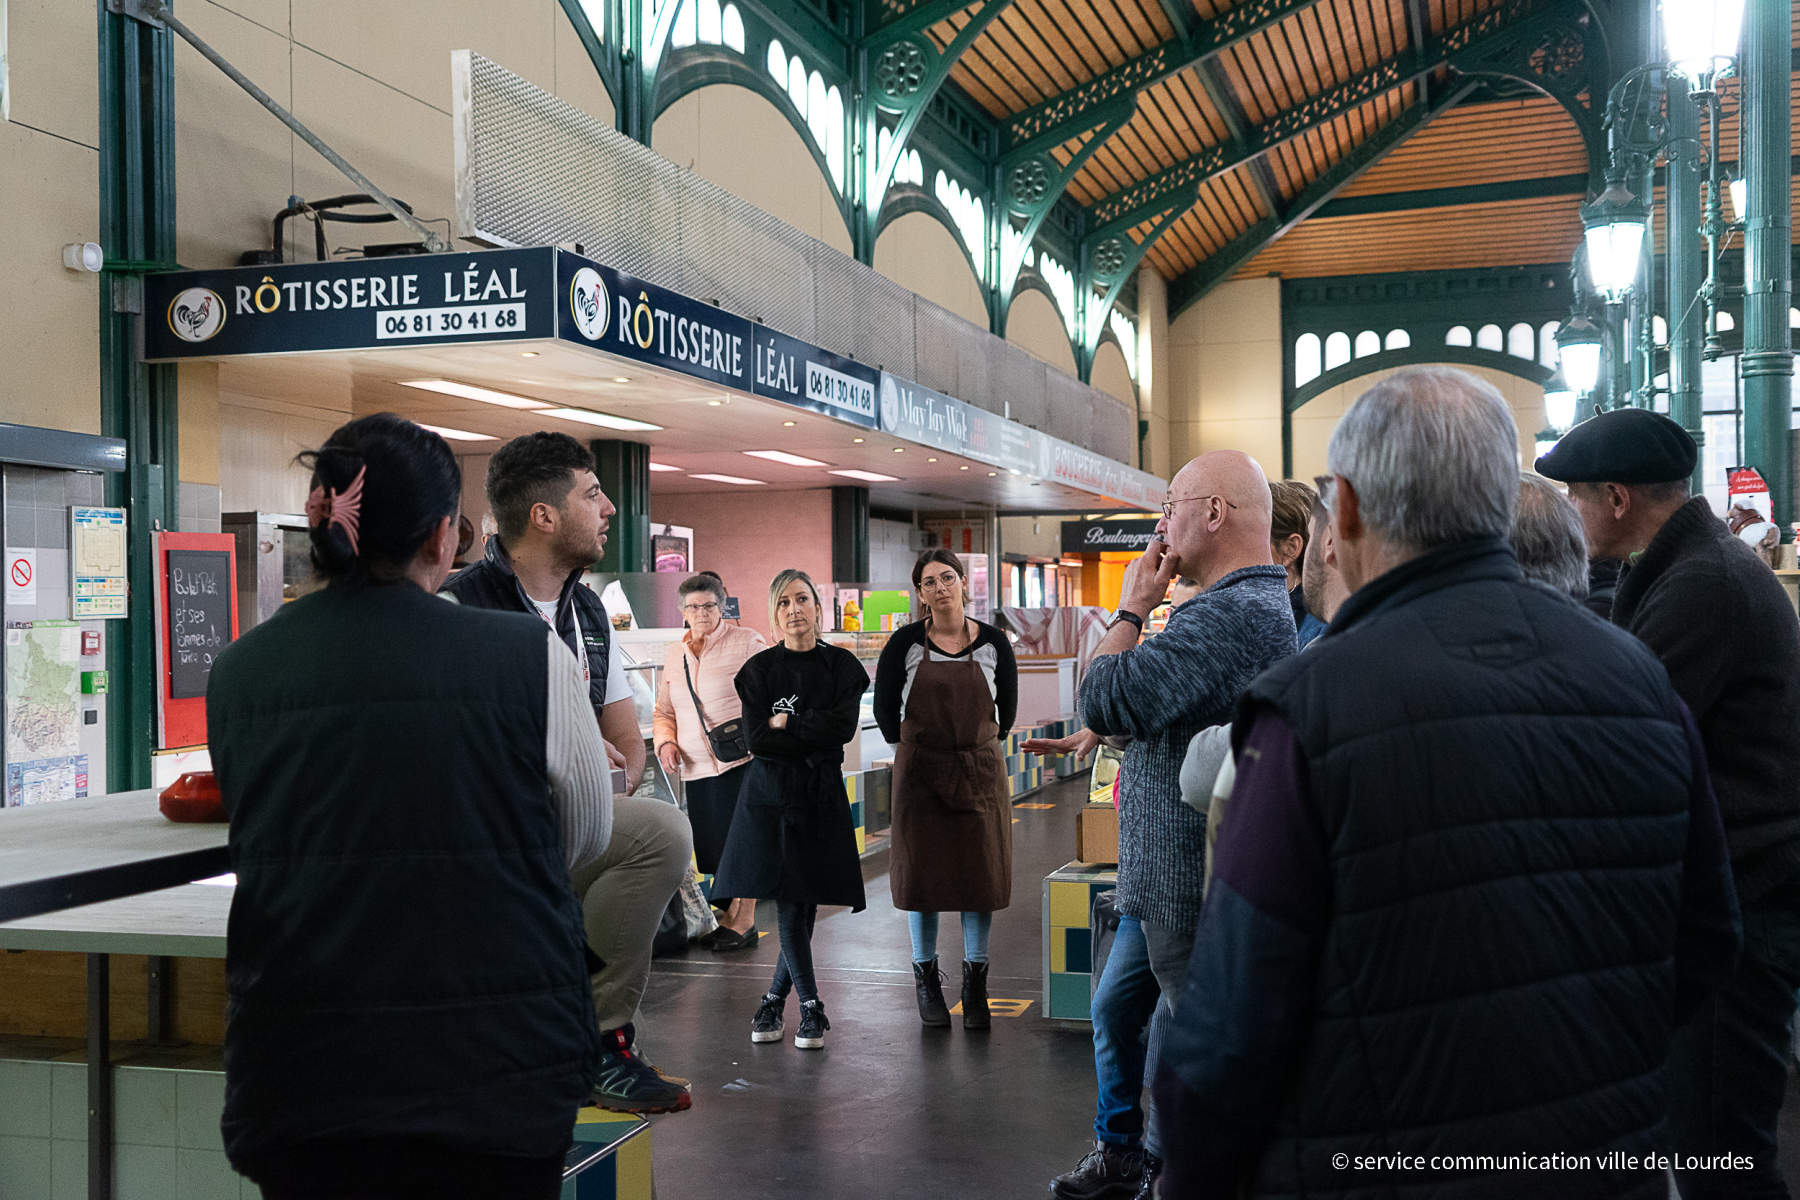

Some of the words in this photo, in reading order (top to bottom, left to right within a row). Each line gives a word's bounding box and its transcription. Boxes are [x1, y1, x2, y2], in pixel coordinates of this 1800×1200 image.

[235, 275, 420, 315] RÔTISSERIE
[444, 262, 527, 303] LÉAL
[385, 316, 407, 334] 06
[413, 314, 432, 332] 81
[441, 312, 462, 331] 30
[468, 311, 486, 329] 41
[495, 309, 517, 328] 68
[619, 291, 743, 378] RÔTISSERIE
[756, 338, 799, 395] LÉAL
[810, 370, 822, 395] 06
[825, 375, 834, 400] 81
[838, 379, 848, 404] 30
[850, 384, 858, 407] 41
[861, 388, 871, 411] 68
[900, 387, 926, 439] May
[926, 396, 946, 445] Tay
[1055, 445, 1103, 489] BOUCHERIE
[175, 600, 186, 624] et
[188, 608, 205, 624] ses
[206, 624, 221, 647] de
